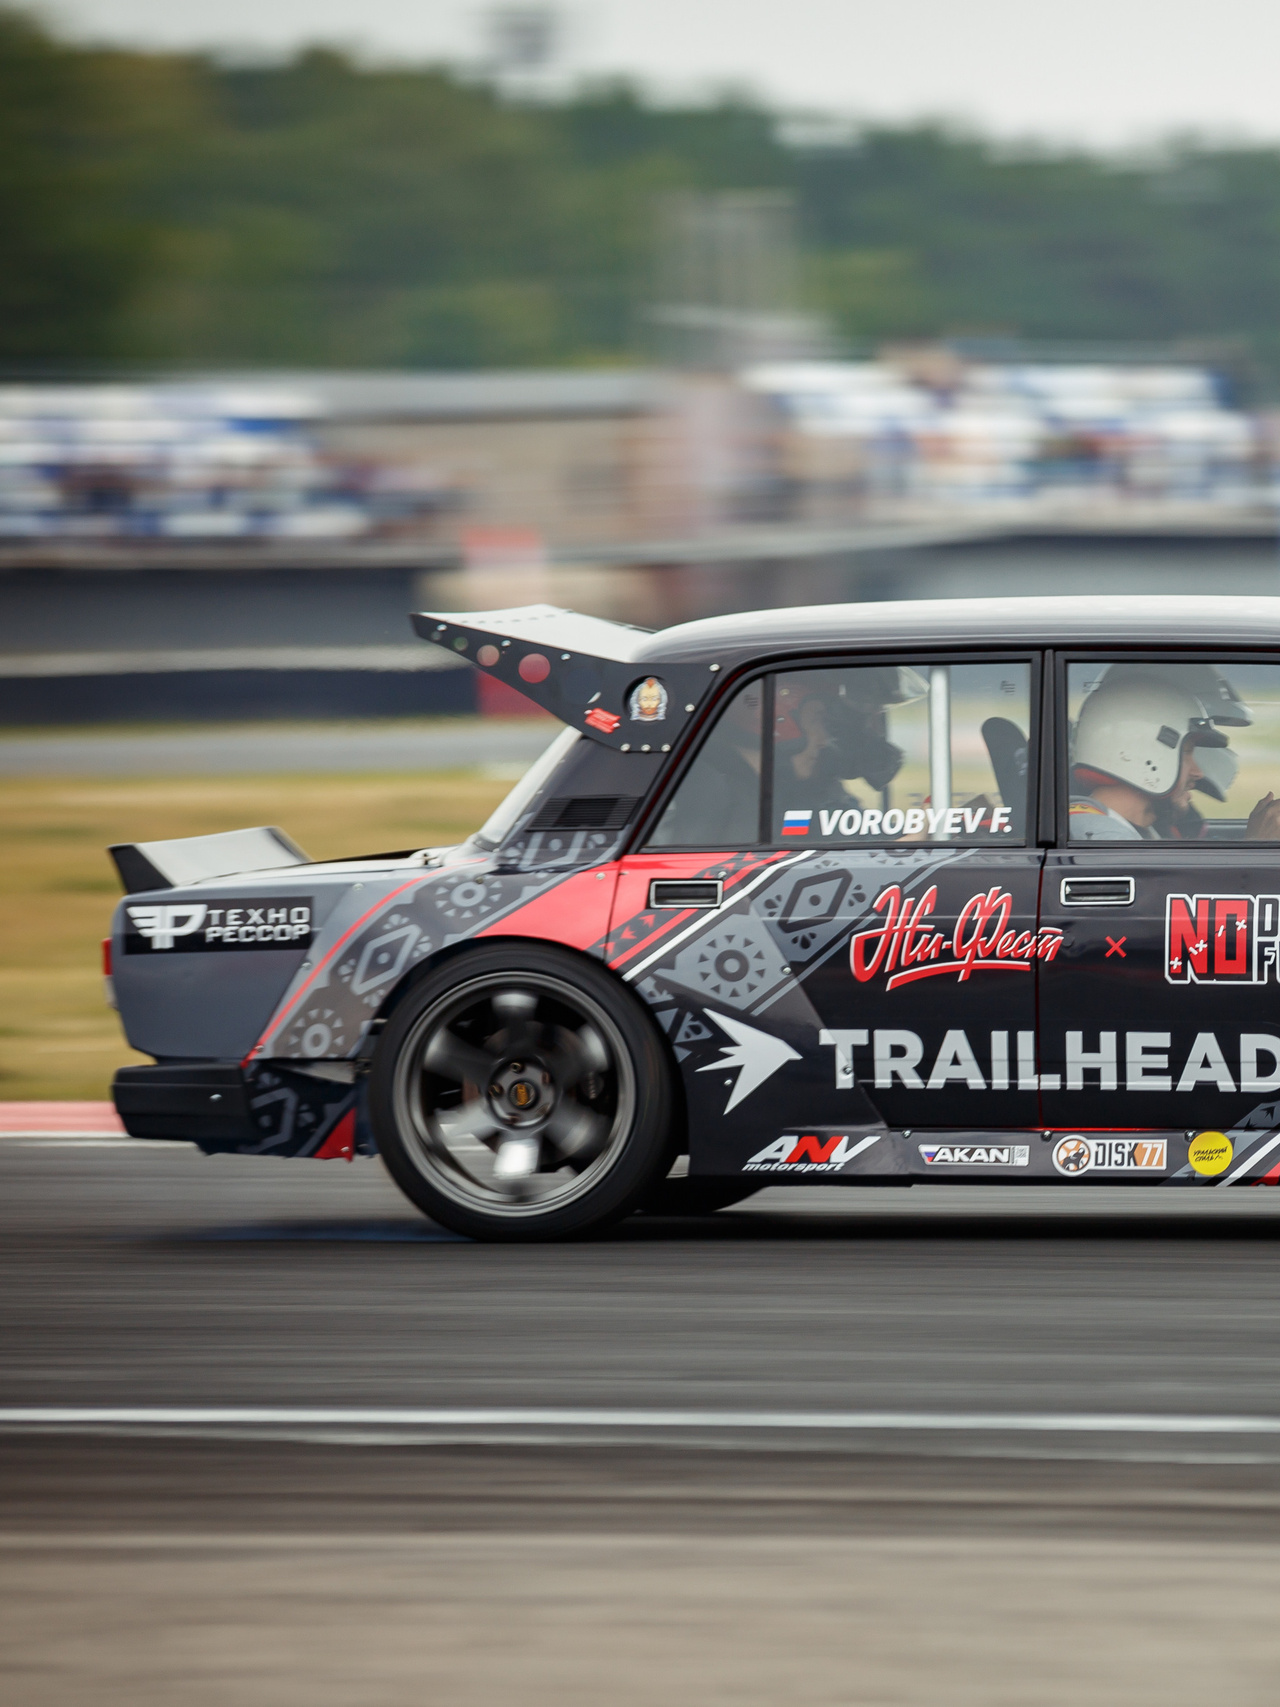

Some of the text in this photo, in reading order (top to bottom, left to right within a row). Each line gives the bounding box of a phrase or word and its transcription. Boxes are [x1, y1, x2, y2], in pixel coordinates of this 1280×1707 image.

[818, 806, 1013, 837] VOROBYEV F.
[206, 906, 311, 926] ТЕХНО
[1167, 896, 1251, 980] NO
[747, 1135, 882, 1163] ANV
[933, 1147, 1010, 1163] AKAN
[741, 1161, 845, 1174] motorsport
